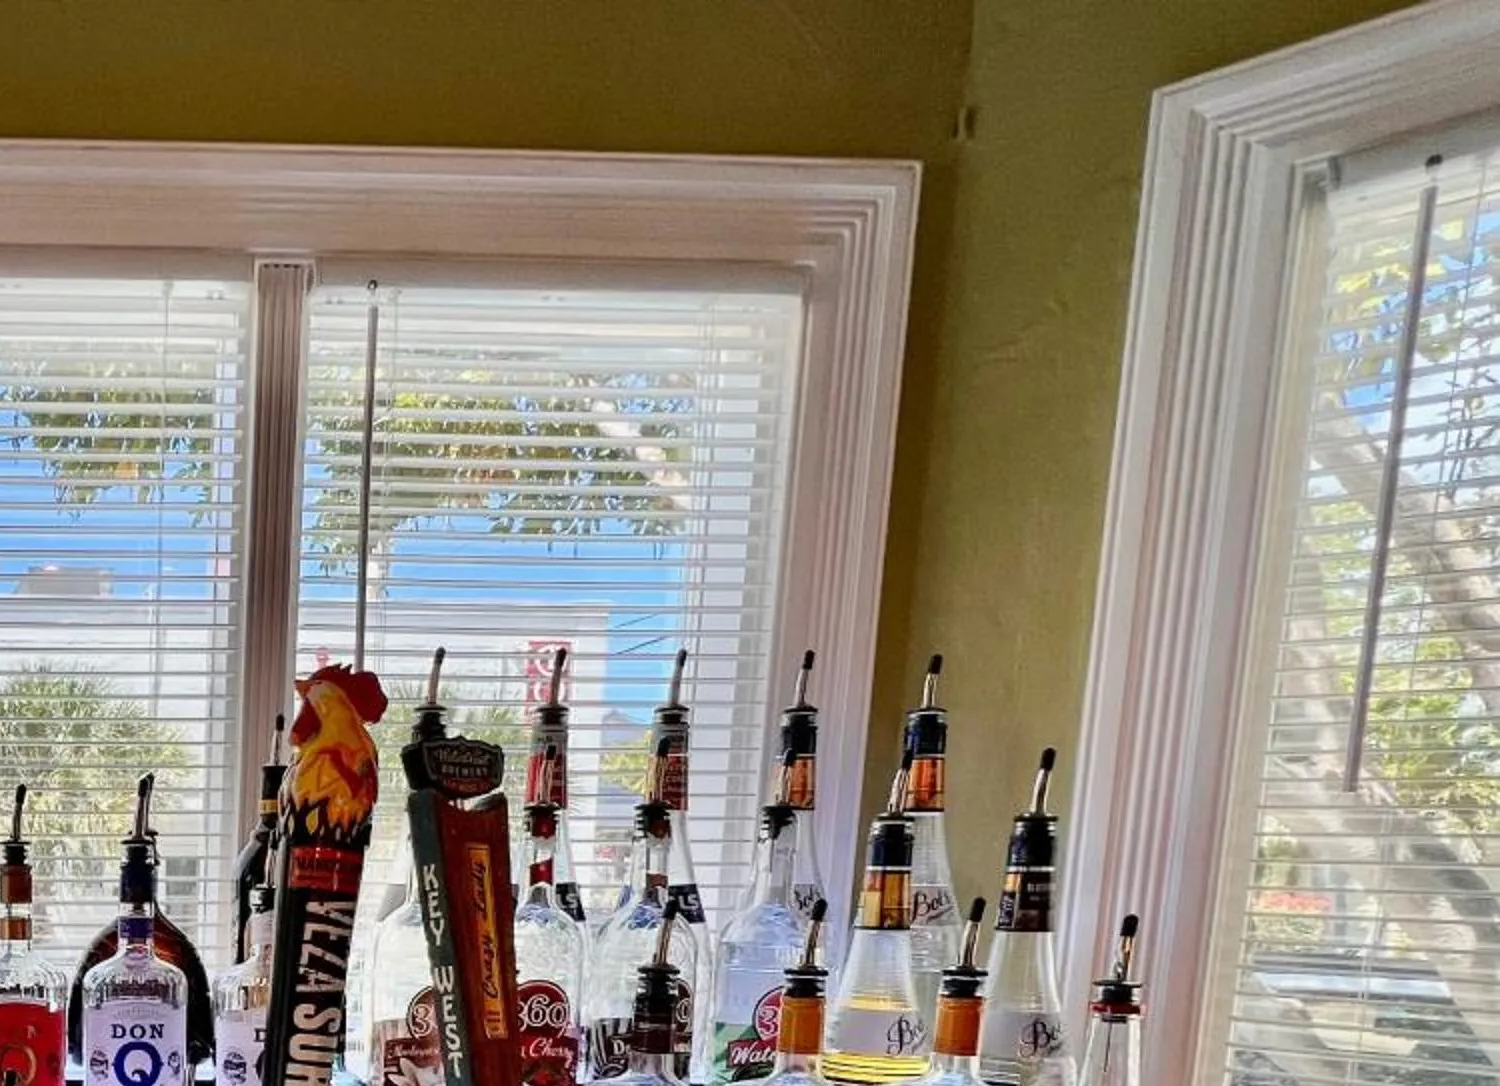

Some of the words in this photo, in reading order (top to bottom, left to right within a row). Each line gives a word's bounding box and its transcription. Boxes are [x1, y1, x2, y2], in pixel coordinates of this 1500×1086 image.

[296, 899, 358, 994] VEZA
[422, 865, 446, 945] KEY
[110, 1023, 165, 1040] DON
[433, 964, 463, 1078] WEST
